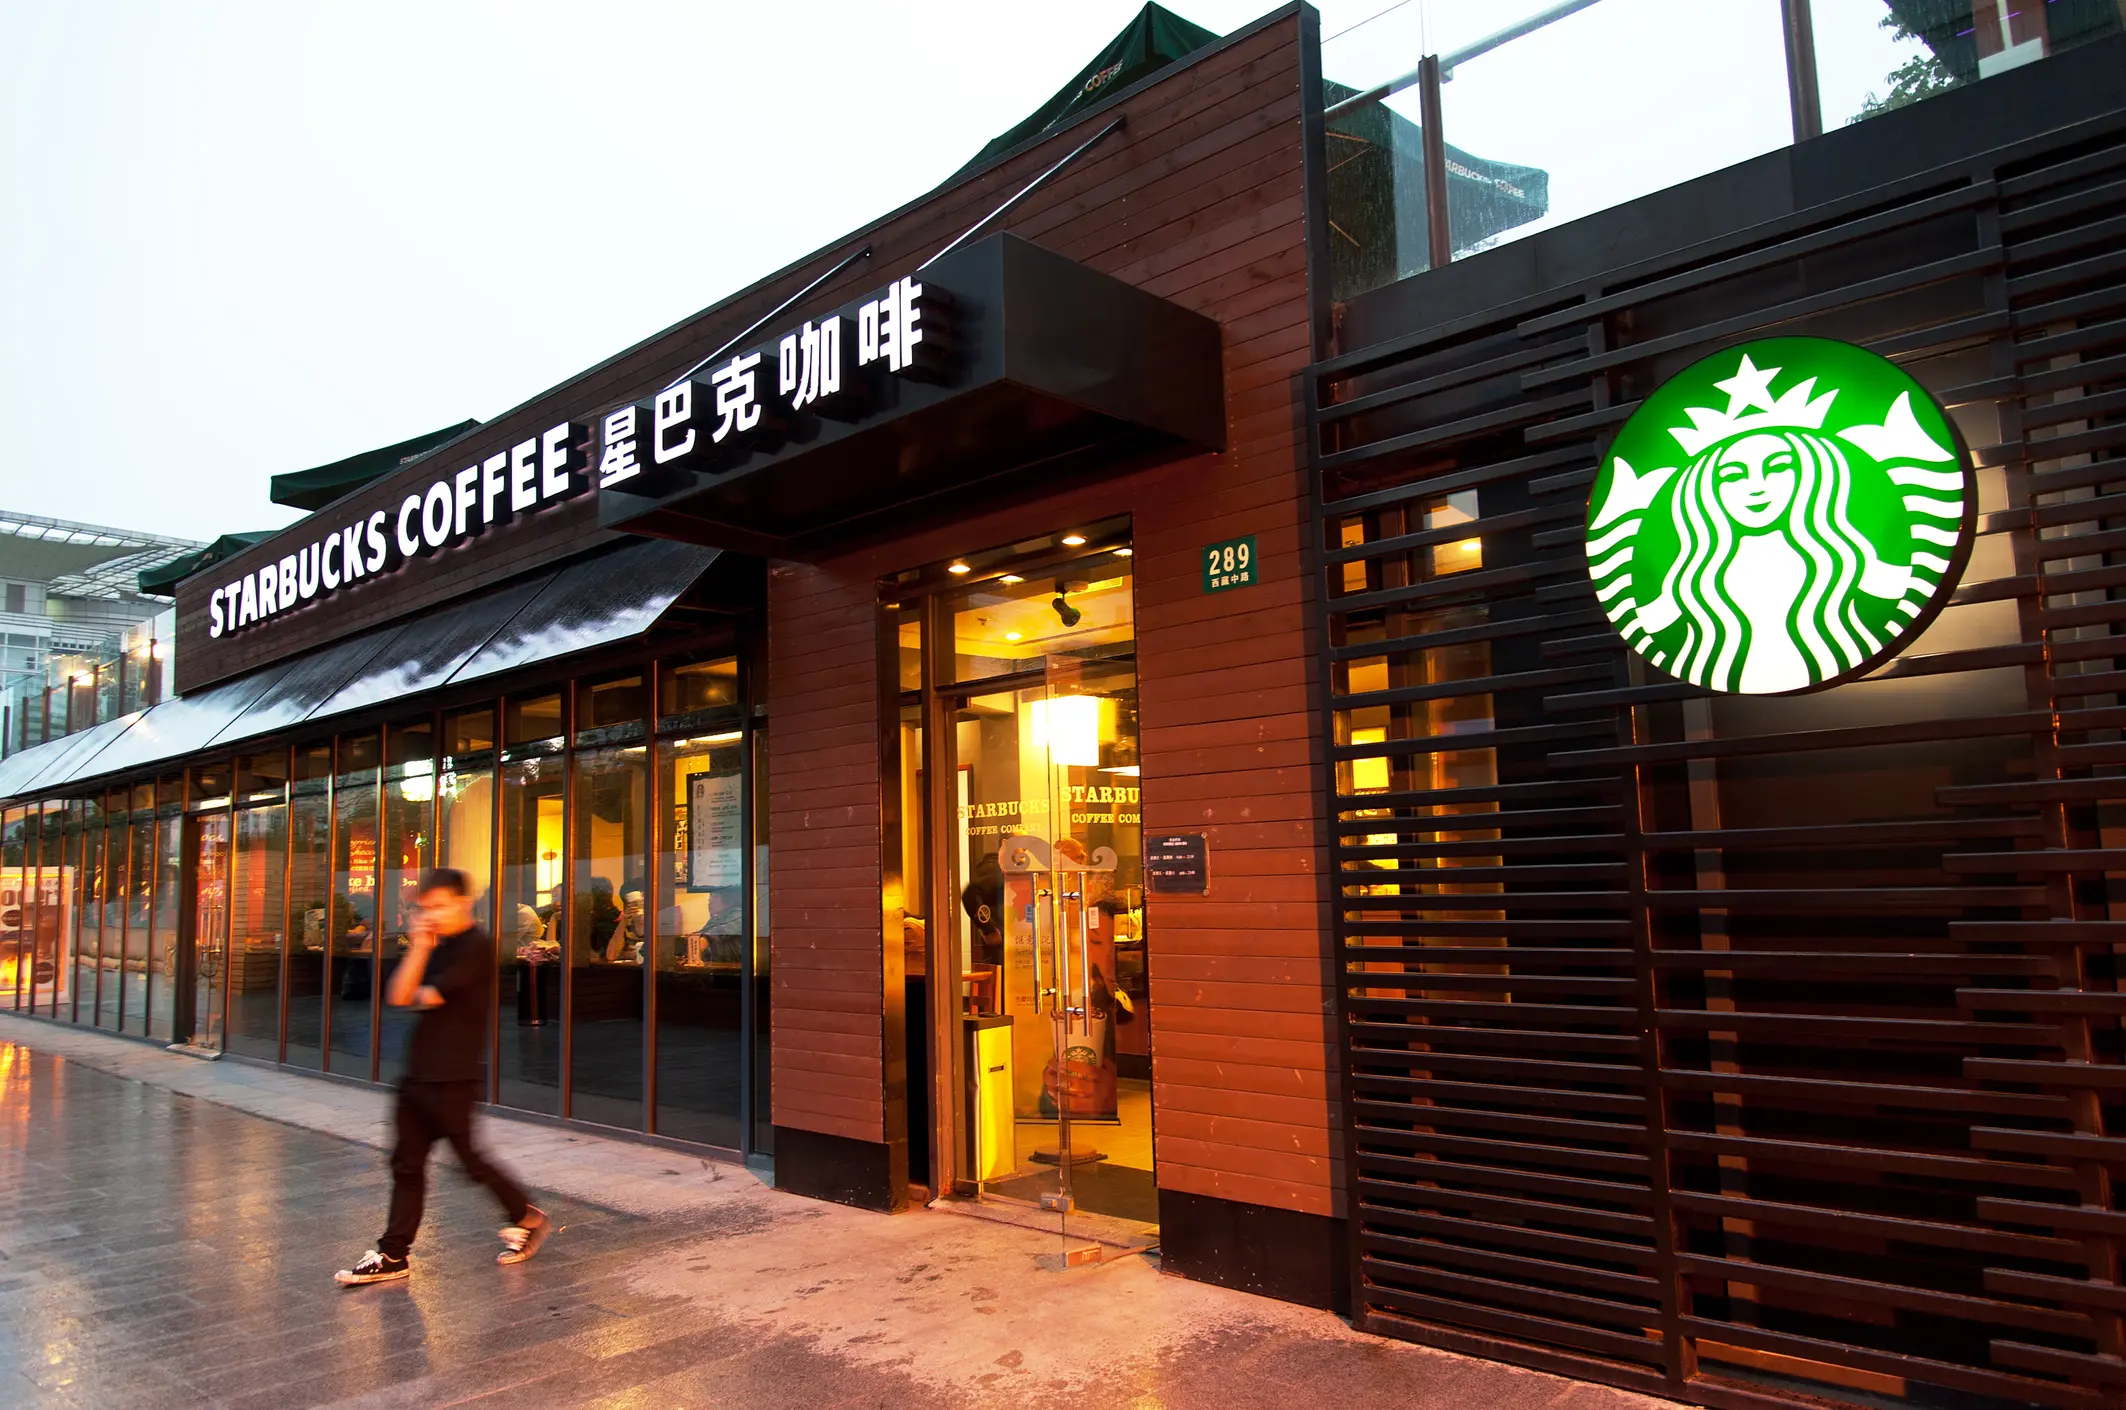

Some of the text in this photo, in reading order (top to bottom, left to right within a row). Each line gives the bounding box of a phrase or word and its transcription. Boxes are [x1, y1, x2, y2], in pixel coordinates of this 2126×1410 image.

[1444, 159, 1492, 184] ARBUCKS
[599, 275, 923, 489] 星巴克咖啡
[209, 421, 570, 639] STARBUCKS COFFEE
[1209, 543, 1249, 576] 289
[957, 798, 1050, 819] STARBUCKS
[1072, 813, 1115, 824] COFFEE
[966, 825, 998, 836] COFFEE
